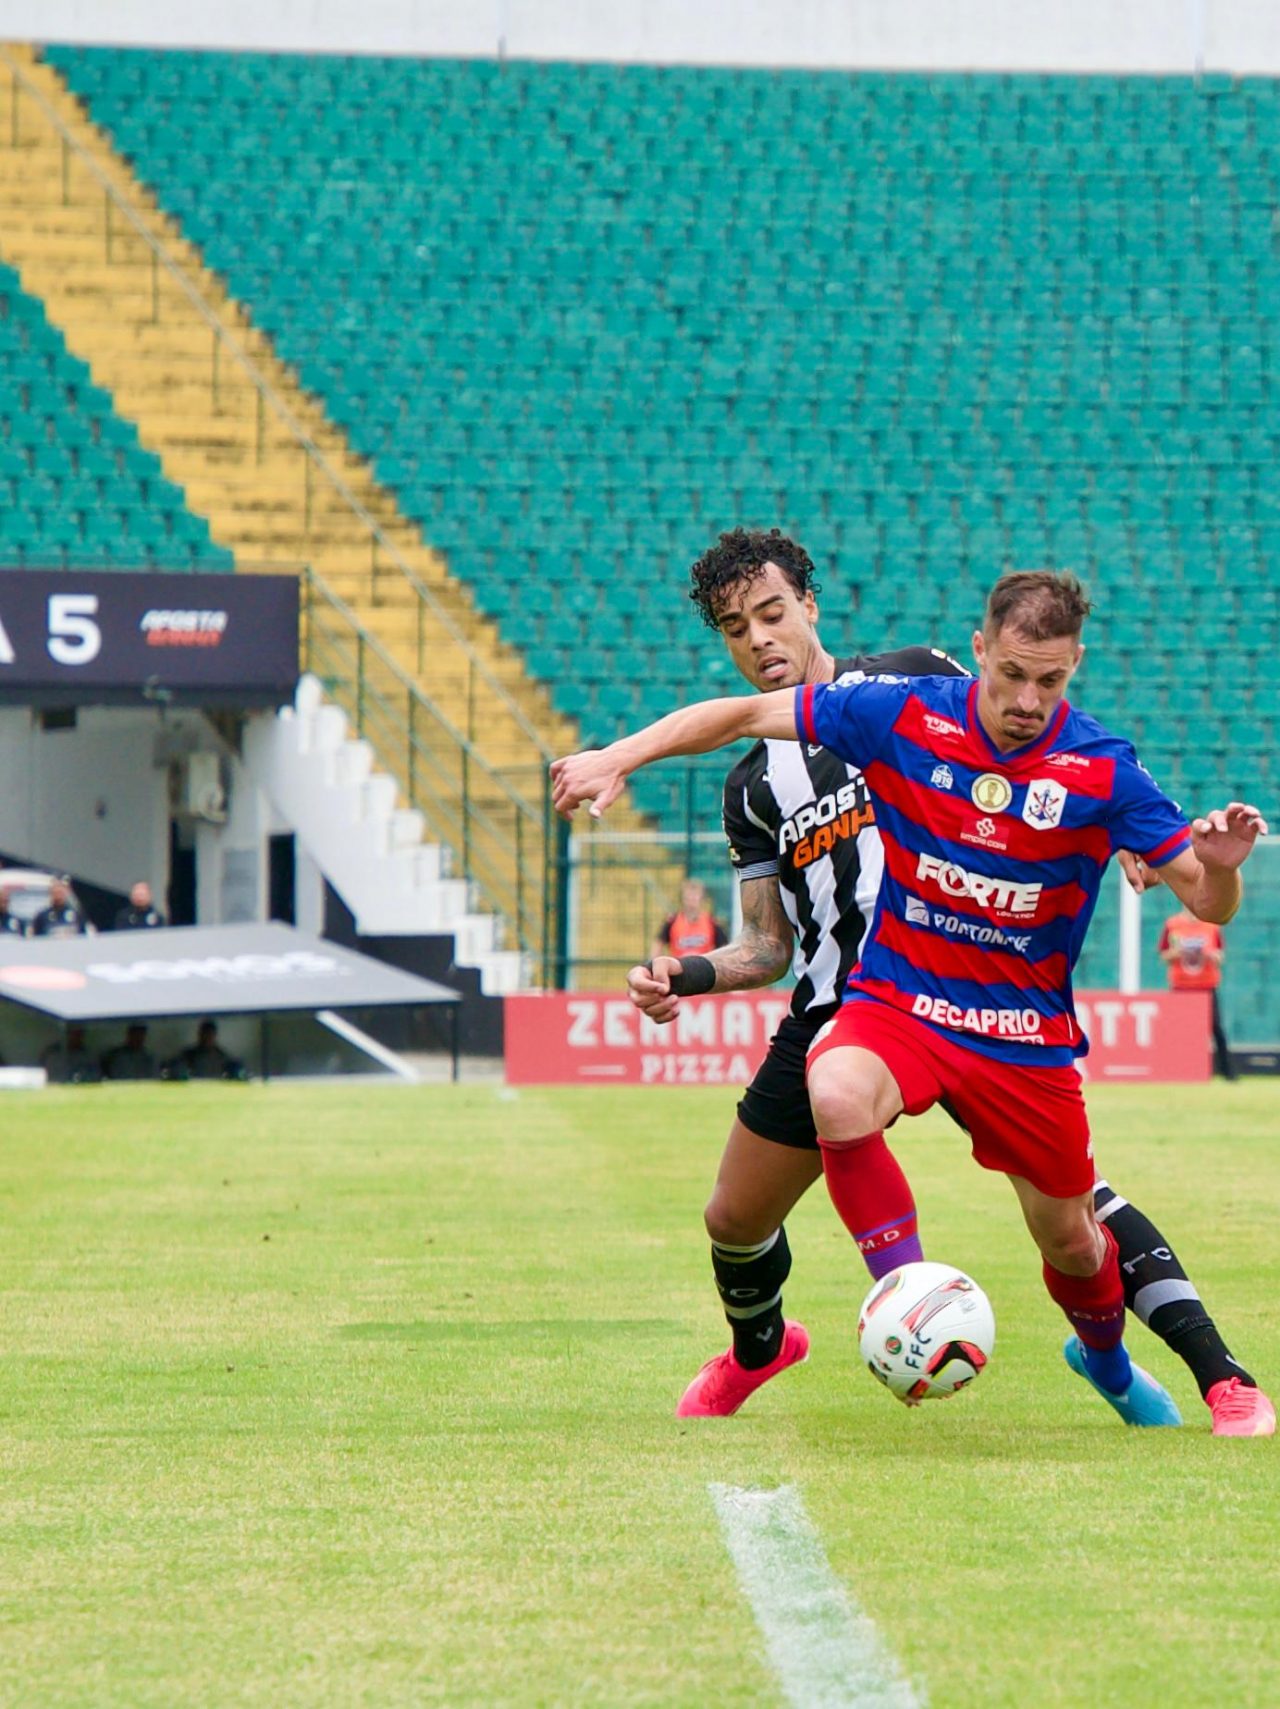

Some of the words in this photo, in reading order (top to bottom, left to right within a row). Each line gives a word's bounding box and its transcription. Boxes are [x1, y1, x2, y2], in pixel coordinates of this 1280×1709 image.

[47, 594, 101, 665] 5
[779, 776, 871, 856] APOST
[793, 803, 876, 869] GANH
[916, 852, 1043, 913] FORTE
[911, 993, 1041, 1036] DECAPRIO
[641, 1053, 750, 1083] PIZZA
